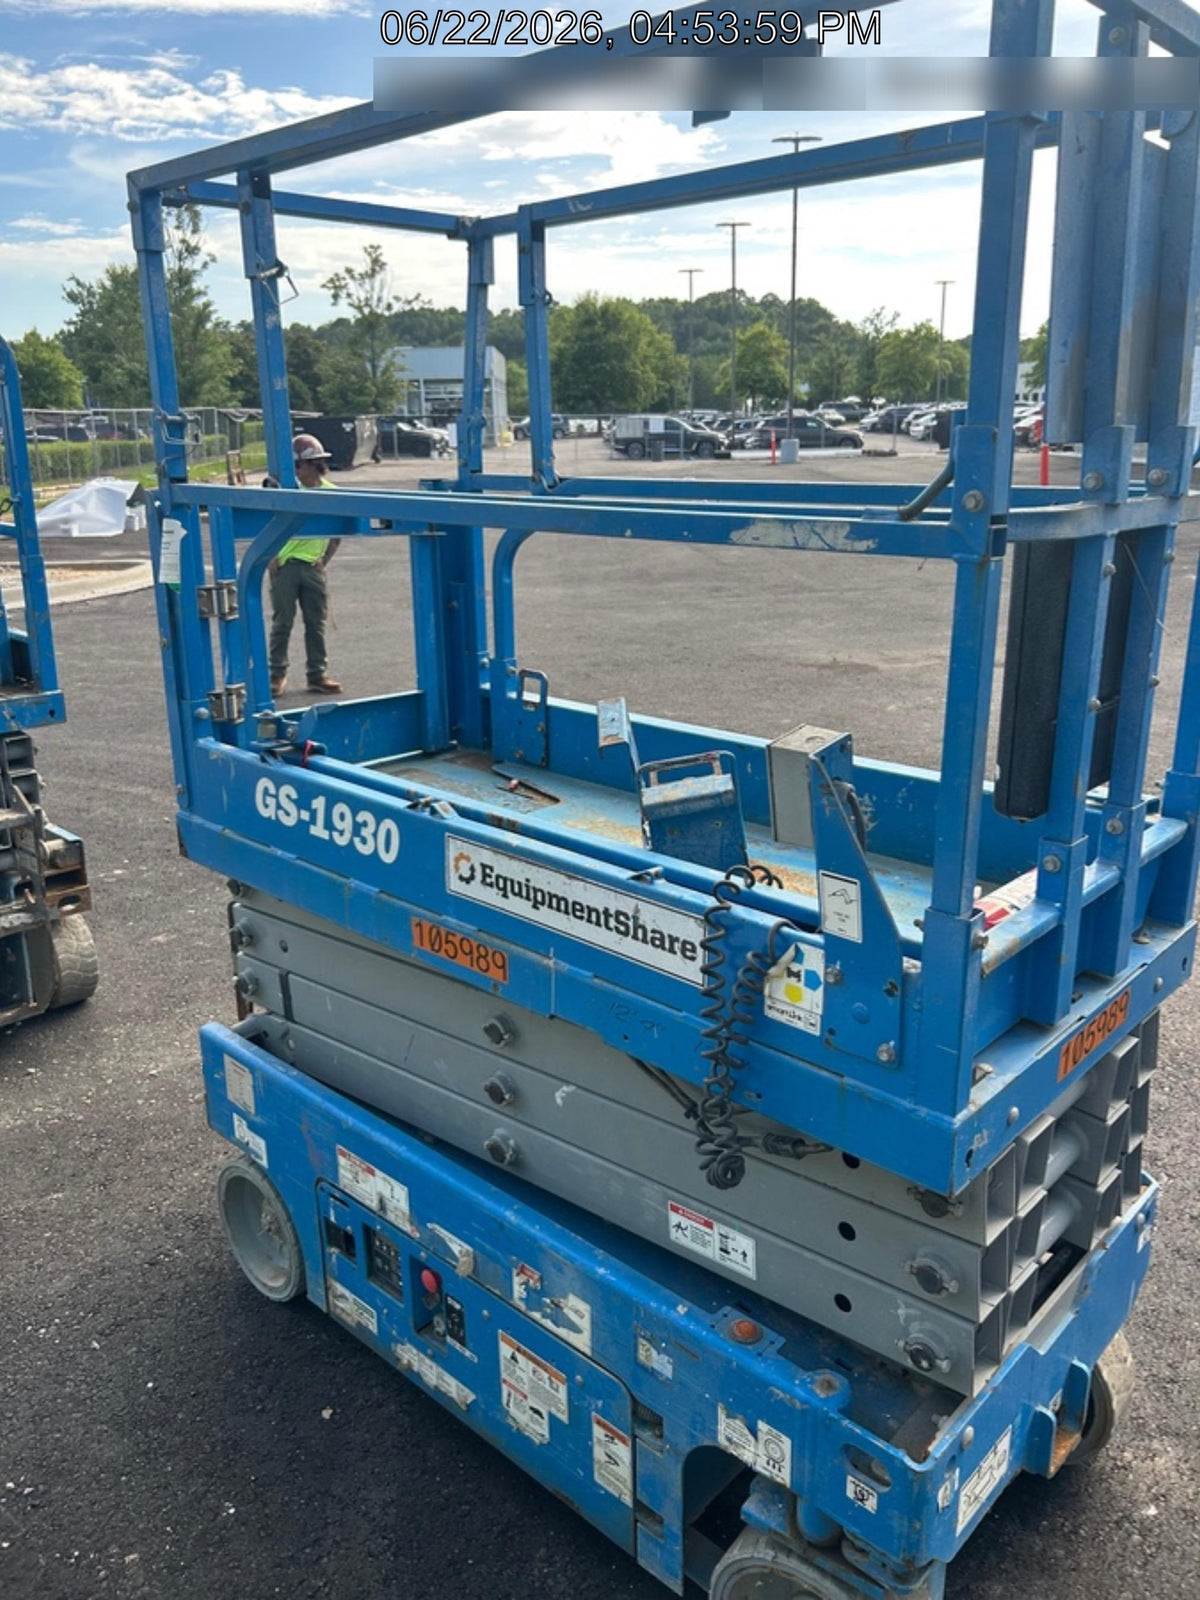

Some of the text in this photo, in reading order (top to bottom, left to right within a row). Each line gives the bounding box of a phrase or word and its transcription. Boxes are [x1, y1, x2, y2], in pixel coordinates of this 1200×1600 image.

[255, 777, 400, 864] GS-1930
[415, 918, 508, 982] 105989
[480, 862, 698, 962] EquipmentShare
